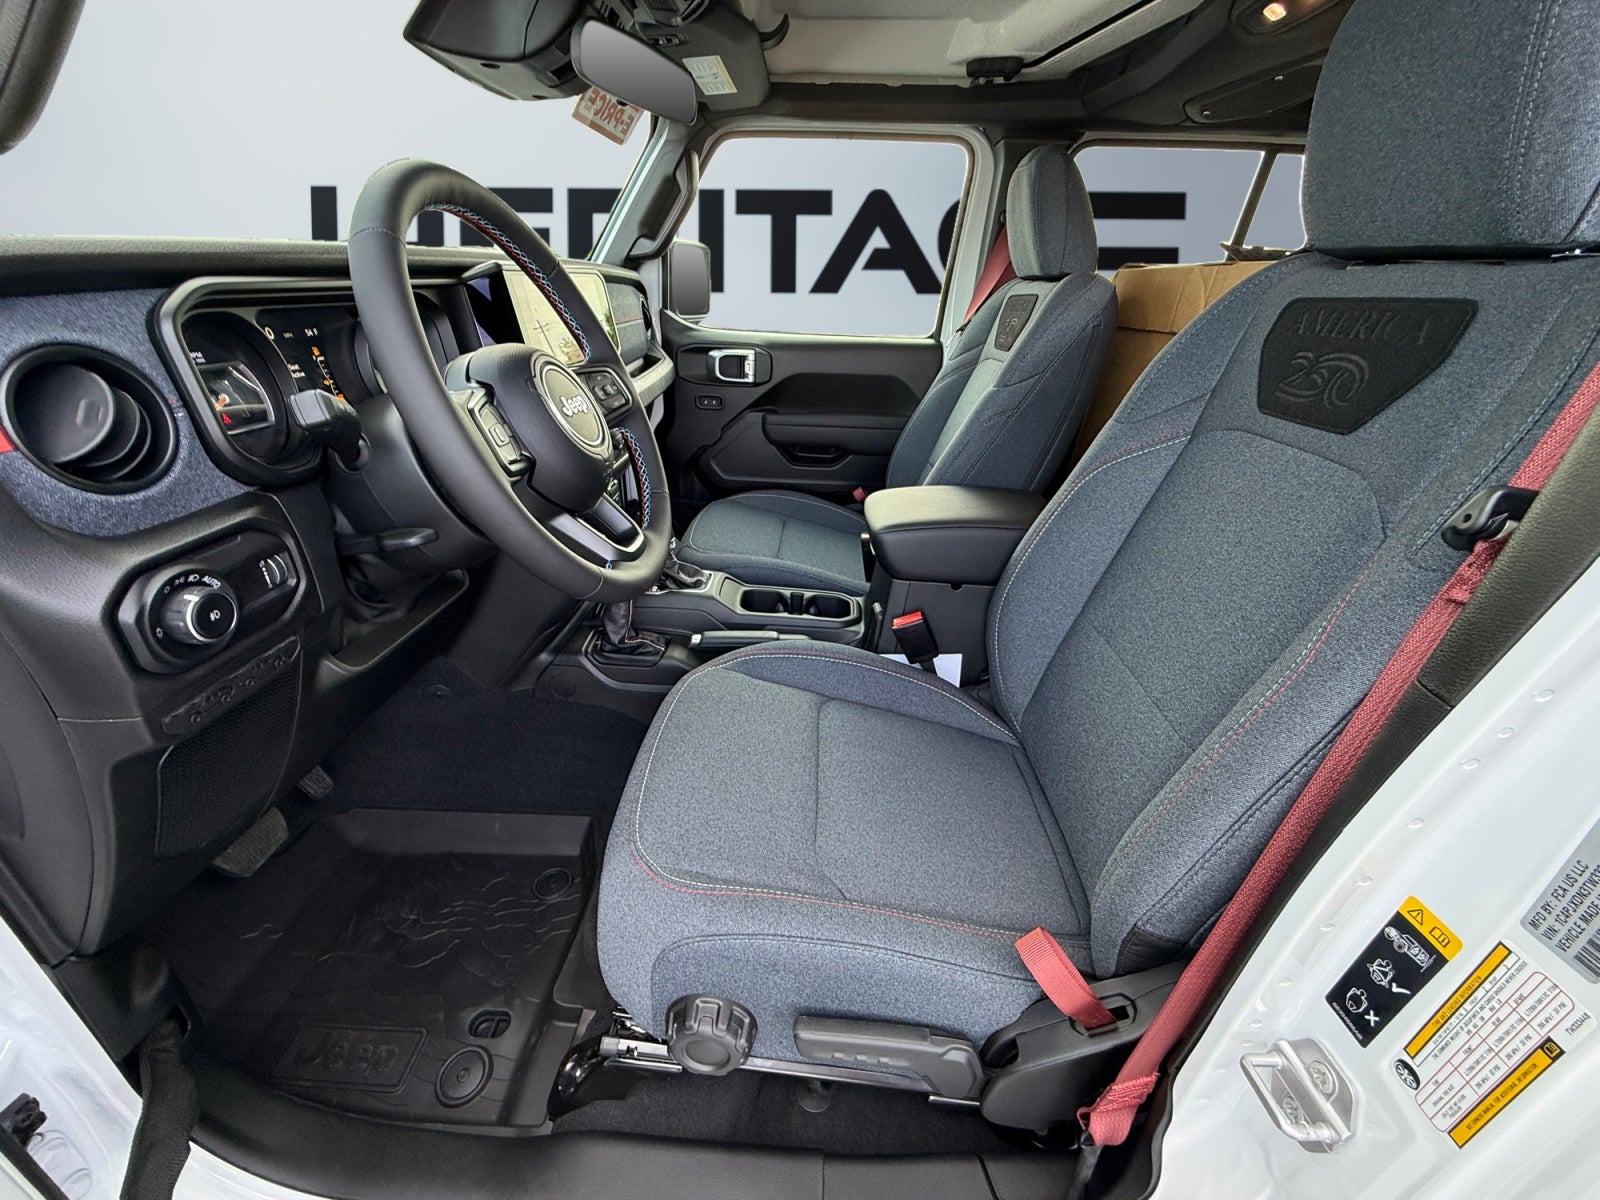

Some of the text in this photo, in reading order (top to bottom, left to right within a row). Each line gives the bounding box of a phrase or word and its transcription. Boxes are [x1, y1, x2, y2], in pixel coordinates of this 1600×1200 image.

[1287, 308, 1433, 346] AMERICA
[1274, 351, 1370, 410] 250
[560, 394, 590, 419] Jeep
[201, 575, 222, 589] AUTO
[1528, 860, 1589, 930] MFD BY: FCA US LLC
[1541, 924, 1560, 941] VIN:
[1555, 900, 1600, 953] VEHICLE MADE
[298, 1031, 399, 1078] Jeep
